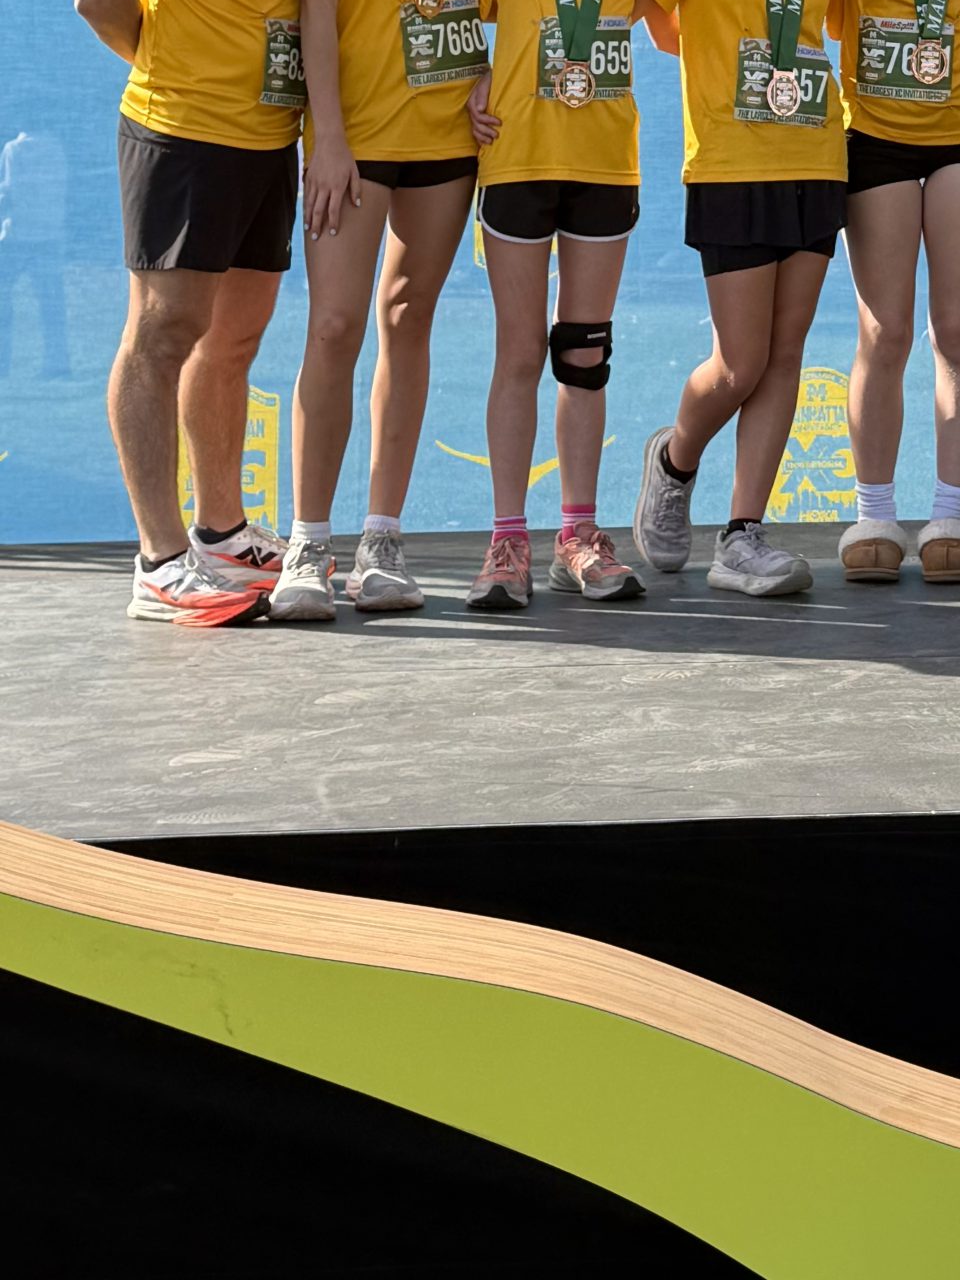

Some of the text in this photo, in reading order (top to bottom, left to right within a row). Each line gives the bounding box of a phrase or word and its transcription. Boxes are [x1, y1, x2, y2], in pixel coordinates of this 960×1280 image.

[431, 18, 487, 58] 7660
[880, 20, 914, 31] MileSplit
[590, 40, 630, 74] 659
[885, 42, 951, 77] 761
[410, 74, 422, 85] THE
[423, 72, 446, 84] LARGEST
[797, 68, 828, 103] 57
[869, 85, 893, 96] LARGEST
[894, 87, 902, 97] XC
